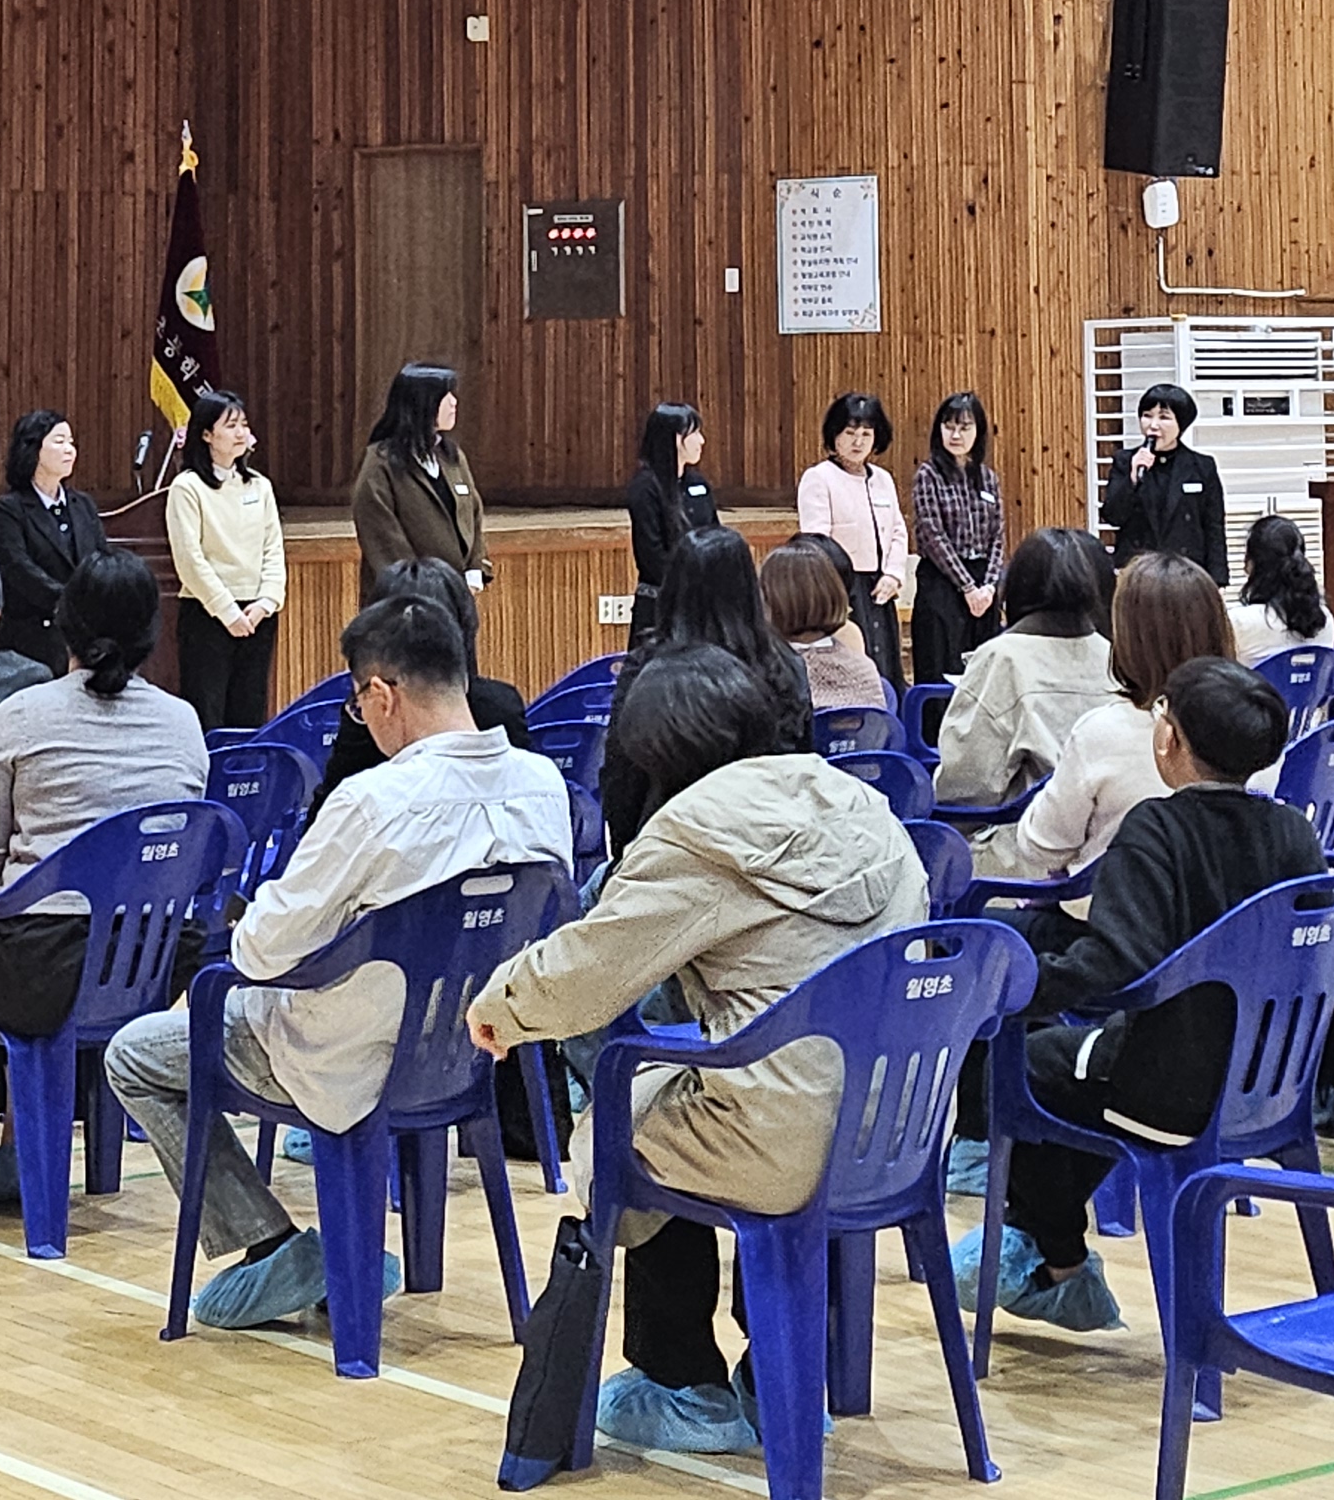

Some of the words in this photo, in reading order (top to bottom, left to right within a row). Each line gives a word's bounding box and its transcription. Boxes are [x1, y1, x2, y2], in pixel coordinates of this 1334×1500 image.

[141, 842, 180, 862] 월영초
[462, 908, 505, 929] 월영초
[1292, 924, 1332, 947] 월영초
[906, 974, 954, 999] 월영초
